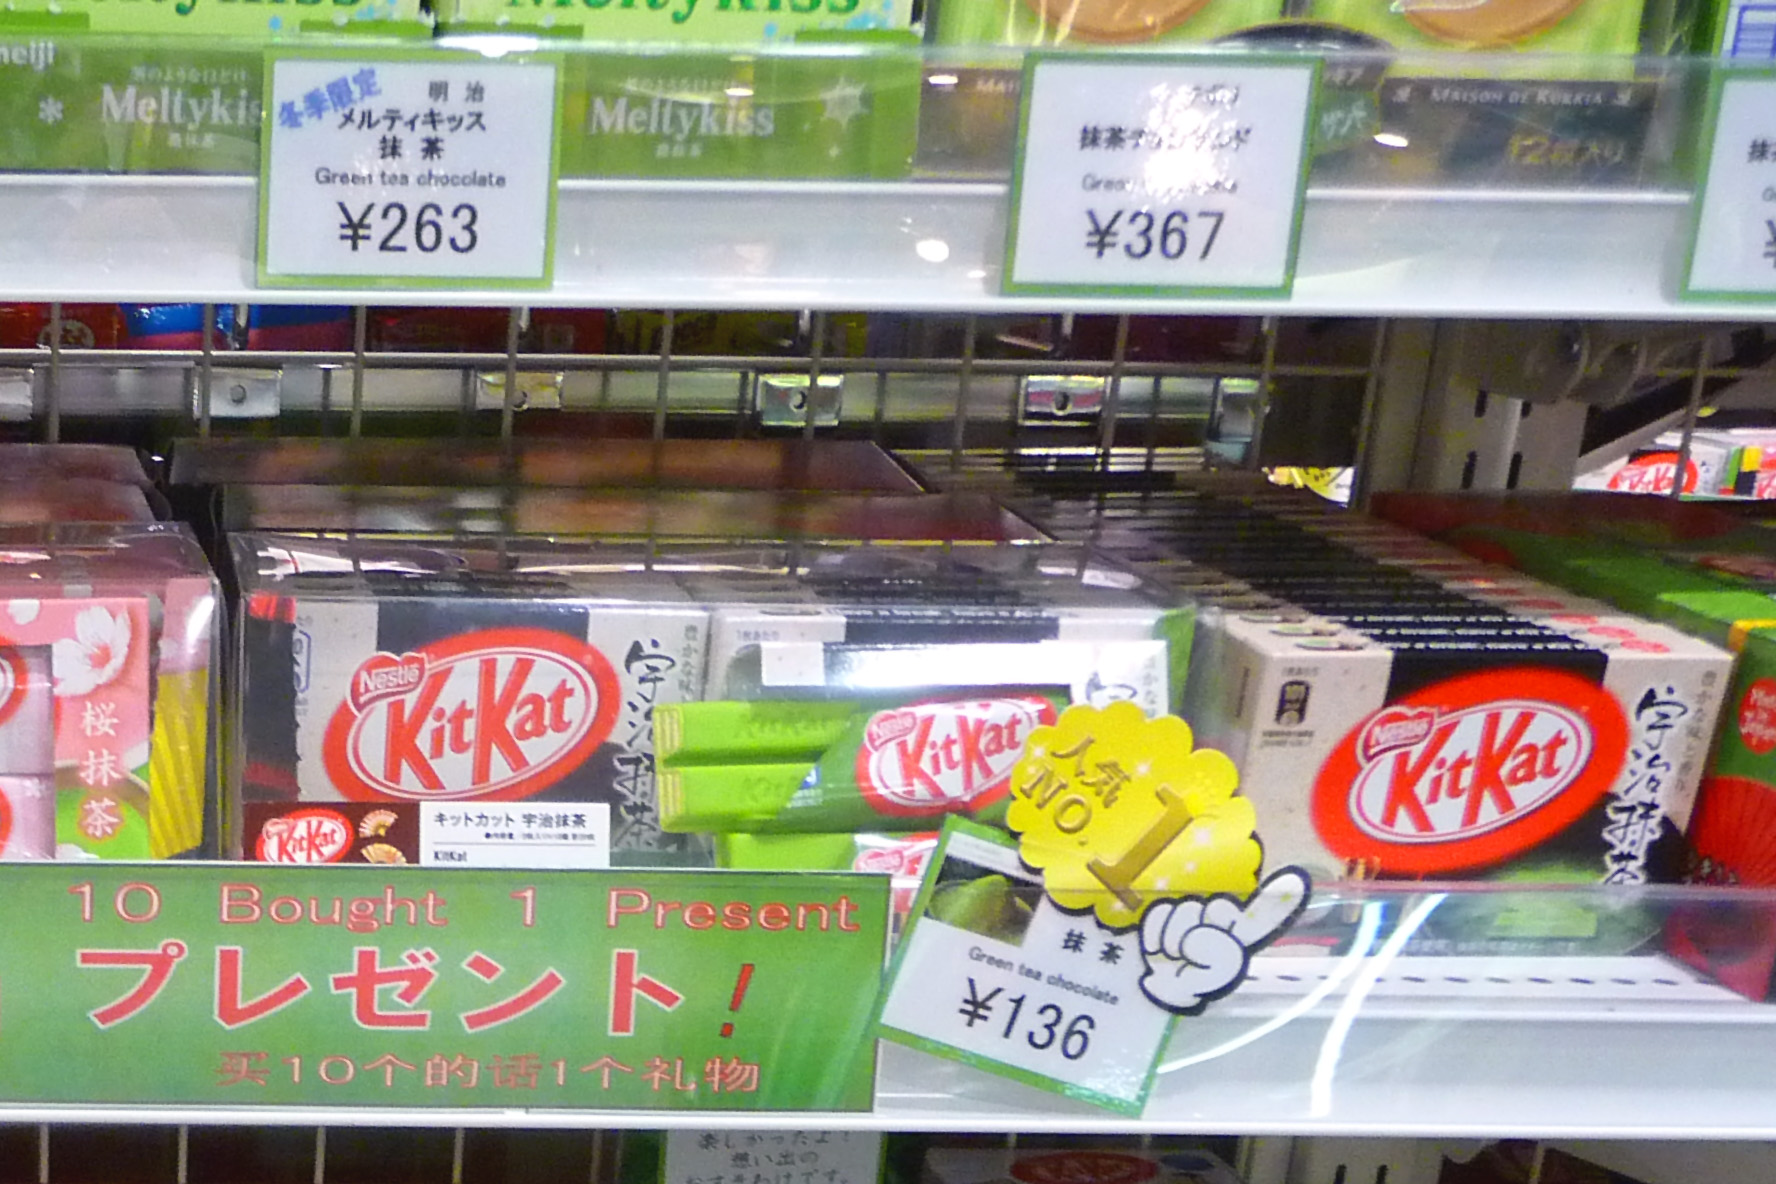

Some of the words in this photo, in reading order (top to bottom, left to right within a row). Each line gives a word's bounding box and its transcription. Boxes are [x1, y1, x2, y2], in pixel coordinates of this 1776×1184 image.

[279, 68, 382, 128] 冬季限定
[337, 108, 486, 132] メルティキッス
[592, 95, 775, 140] Meltykiss
[379, 135, 444, 160] 抹茶
[315, 167, 373, 186] Green
[380, 170, 409, 186] tea
[417, 169, 506, 188] chocolate
[337, 201, 479, 253] ¥263
[1085, 208, 1225, 260] ¥367
[359, 661, 421, 694] Nestlé
[384, 656, 576, 792] KitKat
[80, 701, 120, 838] 桜抹茶
[895, 703, 1023, 801] KitKat
[1052, 735, 1132, 810] 人気
[1381, 710, 1568, 833] KitKat
[434, 812, 515, 828] キットカット
[522, 812, 587, 829] 宇治抹茶
[1086, 783, 1195, 911] 1
[67, 881, 163, 924] 10
[219, 882, 450, 934] Bought
[512, 887, 537, 928] 1
[606, 888, 861, 933] Present
[1062, 929, 1125, 965] 抹茶
[968, 945, 1014, 973] Green
[1017, 963, 1042, 982] tea
[1047, 970, 1120, 1006] chocolate
[957, 976, 1096, 1061] ¥136
